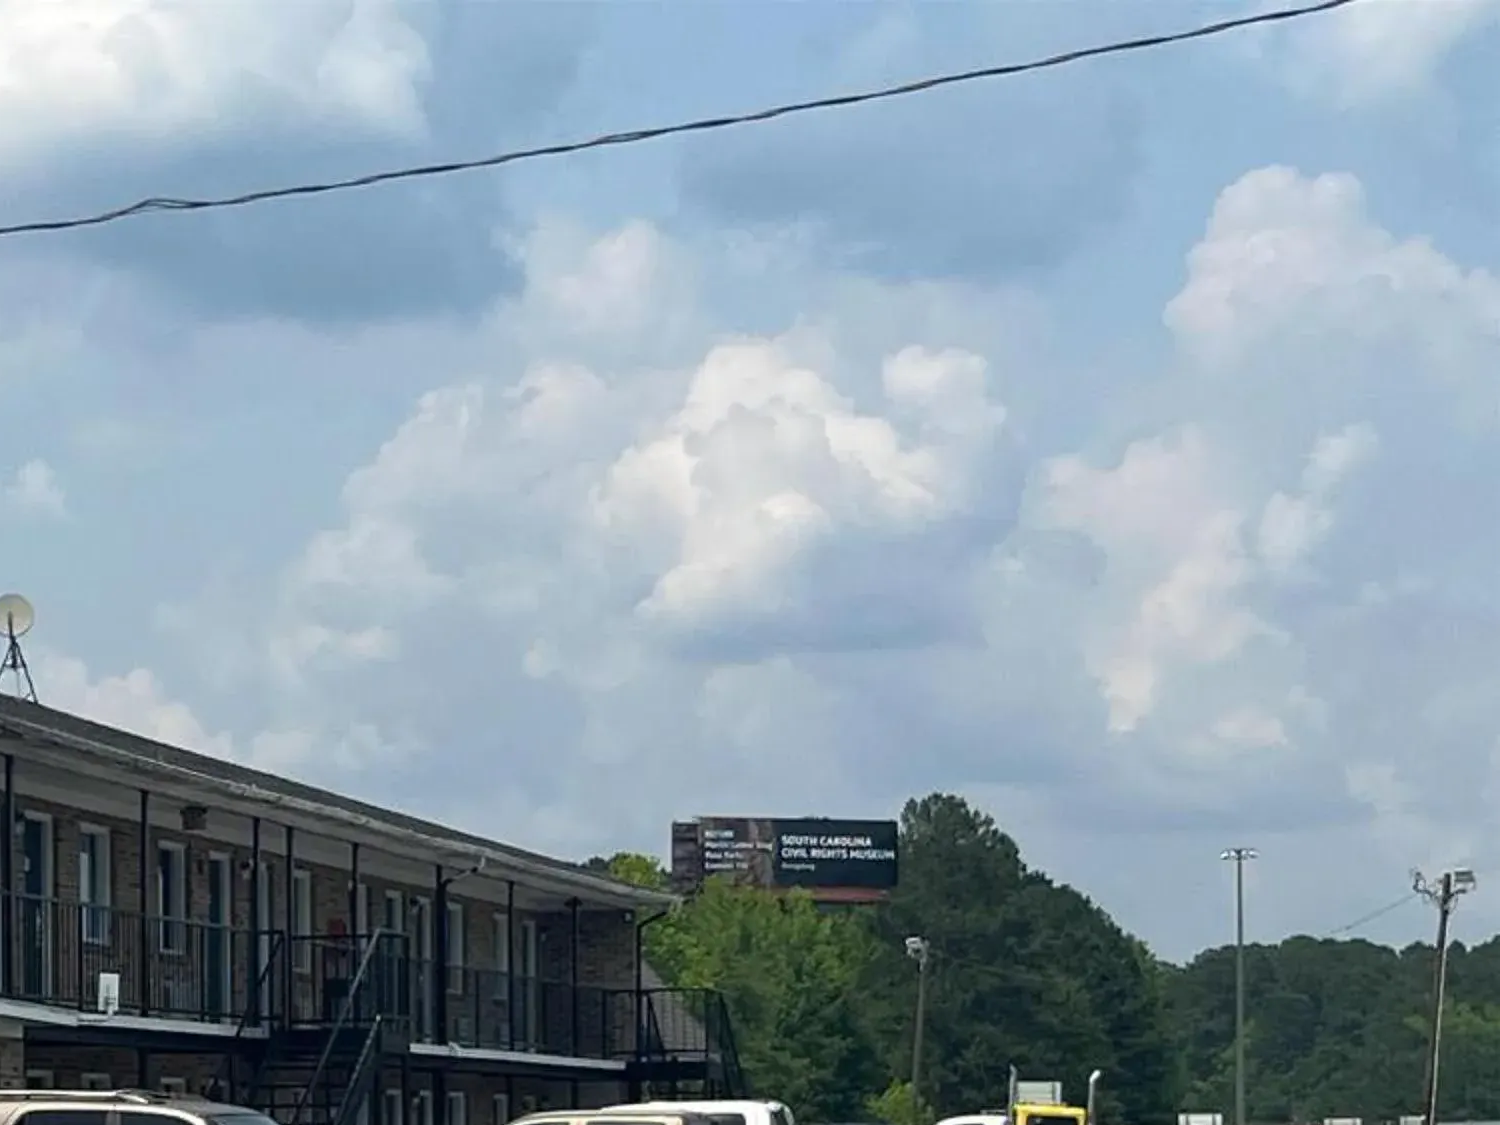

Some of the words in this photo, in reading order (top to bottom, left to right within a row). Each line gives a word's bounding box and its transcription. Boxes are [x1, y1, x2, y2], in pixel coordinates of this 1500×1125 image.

[781, 835, 818, 846] SOUTH
[820, 836, 872, 847] CAROLINA
[781, 847, 808, 859] CIVIL
[810, 848, 848, 859] RIGHTS
[850, 849, 895, 860] MUSEUM
